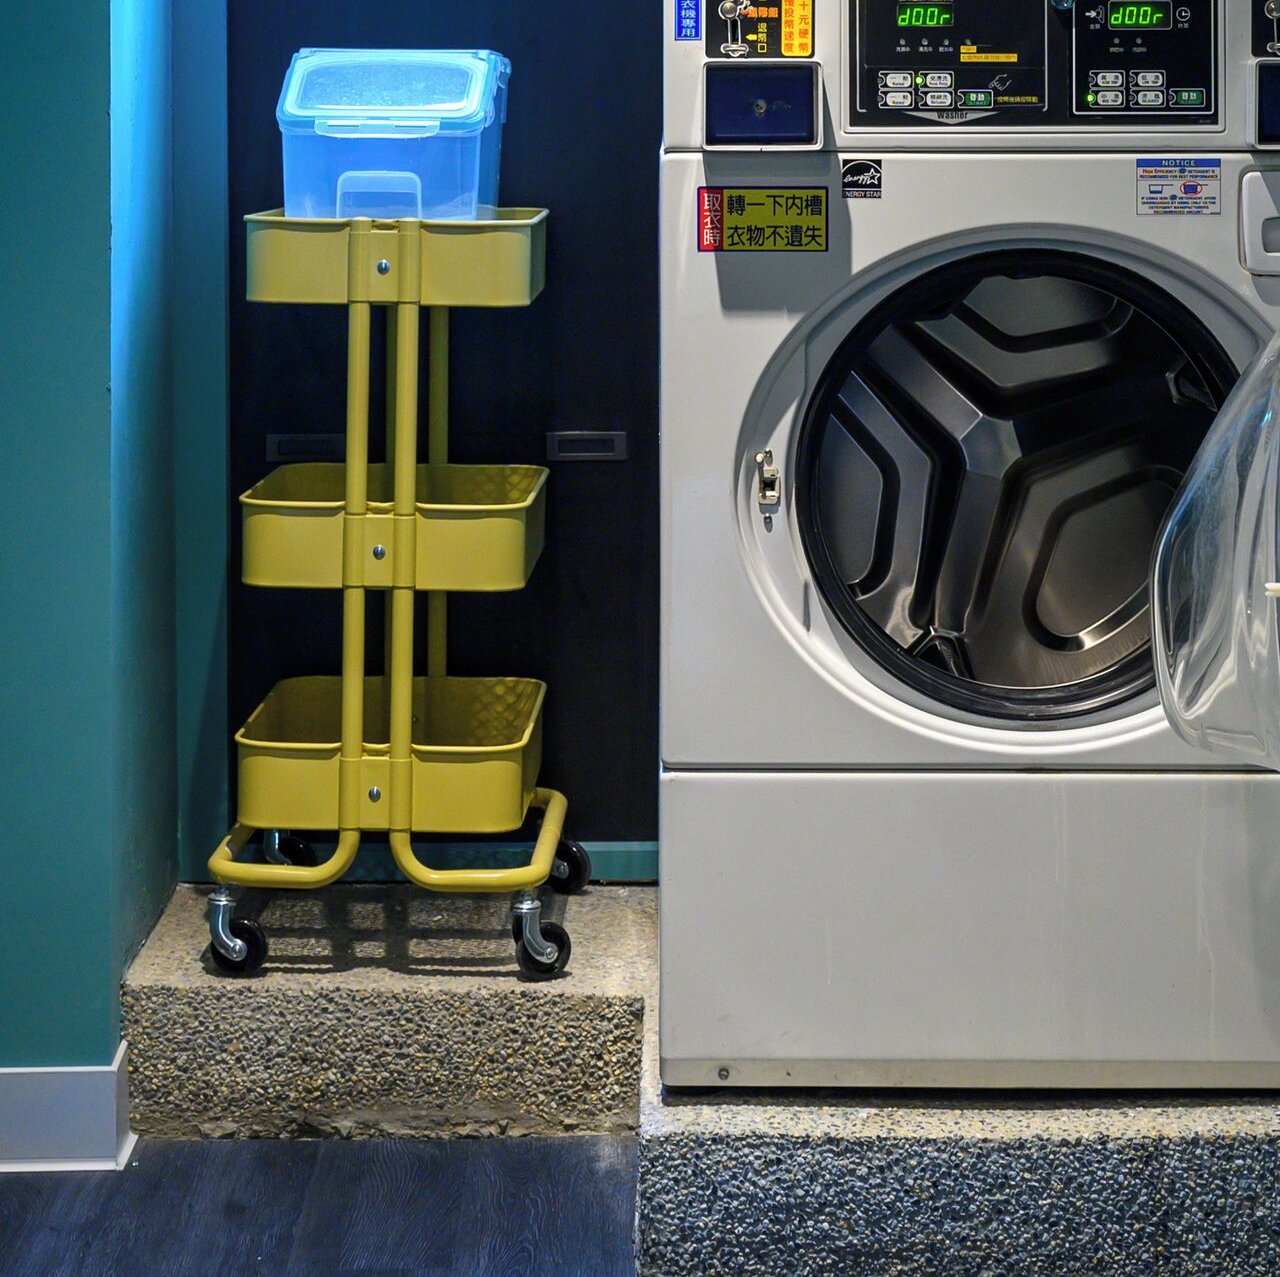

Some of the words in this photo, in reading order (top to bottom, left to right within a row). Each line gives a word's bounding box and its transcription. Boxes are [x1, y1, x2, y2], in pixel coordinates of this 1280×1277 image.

[937, 111, 968, 120] Washer
[704, 193, 720, 247] 取衣時
[727, 226, 822, 247] 衣物不遺失
